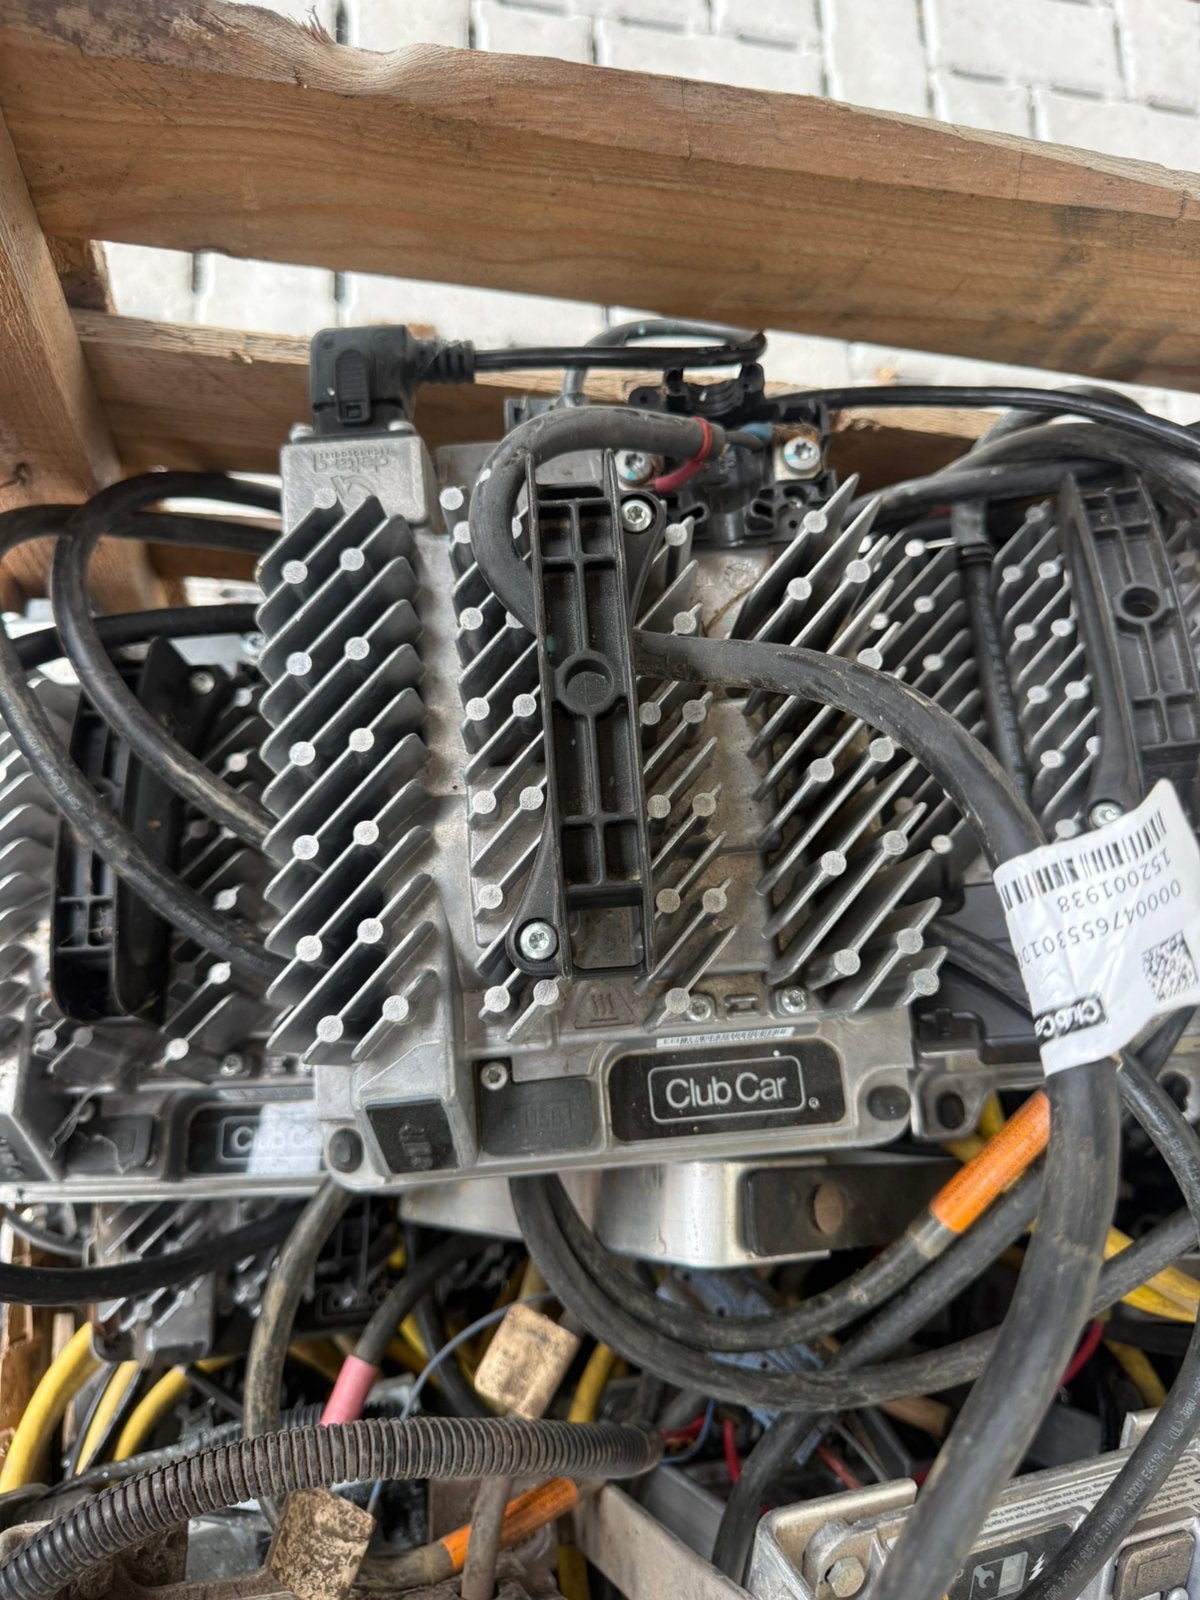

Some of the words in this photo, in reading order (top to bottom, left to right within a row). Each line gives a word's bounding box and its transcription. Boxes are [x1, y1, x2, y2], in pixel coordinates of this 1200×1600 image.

[1057, 847, 1171, 913] 152001938
[1034, 1015, 1056, 1038] Ca
[1055, 1000, 1101, 1032] Club
[665, 1076, 733, 1109] Club
[735, 1072, 787, 1102] Car
